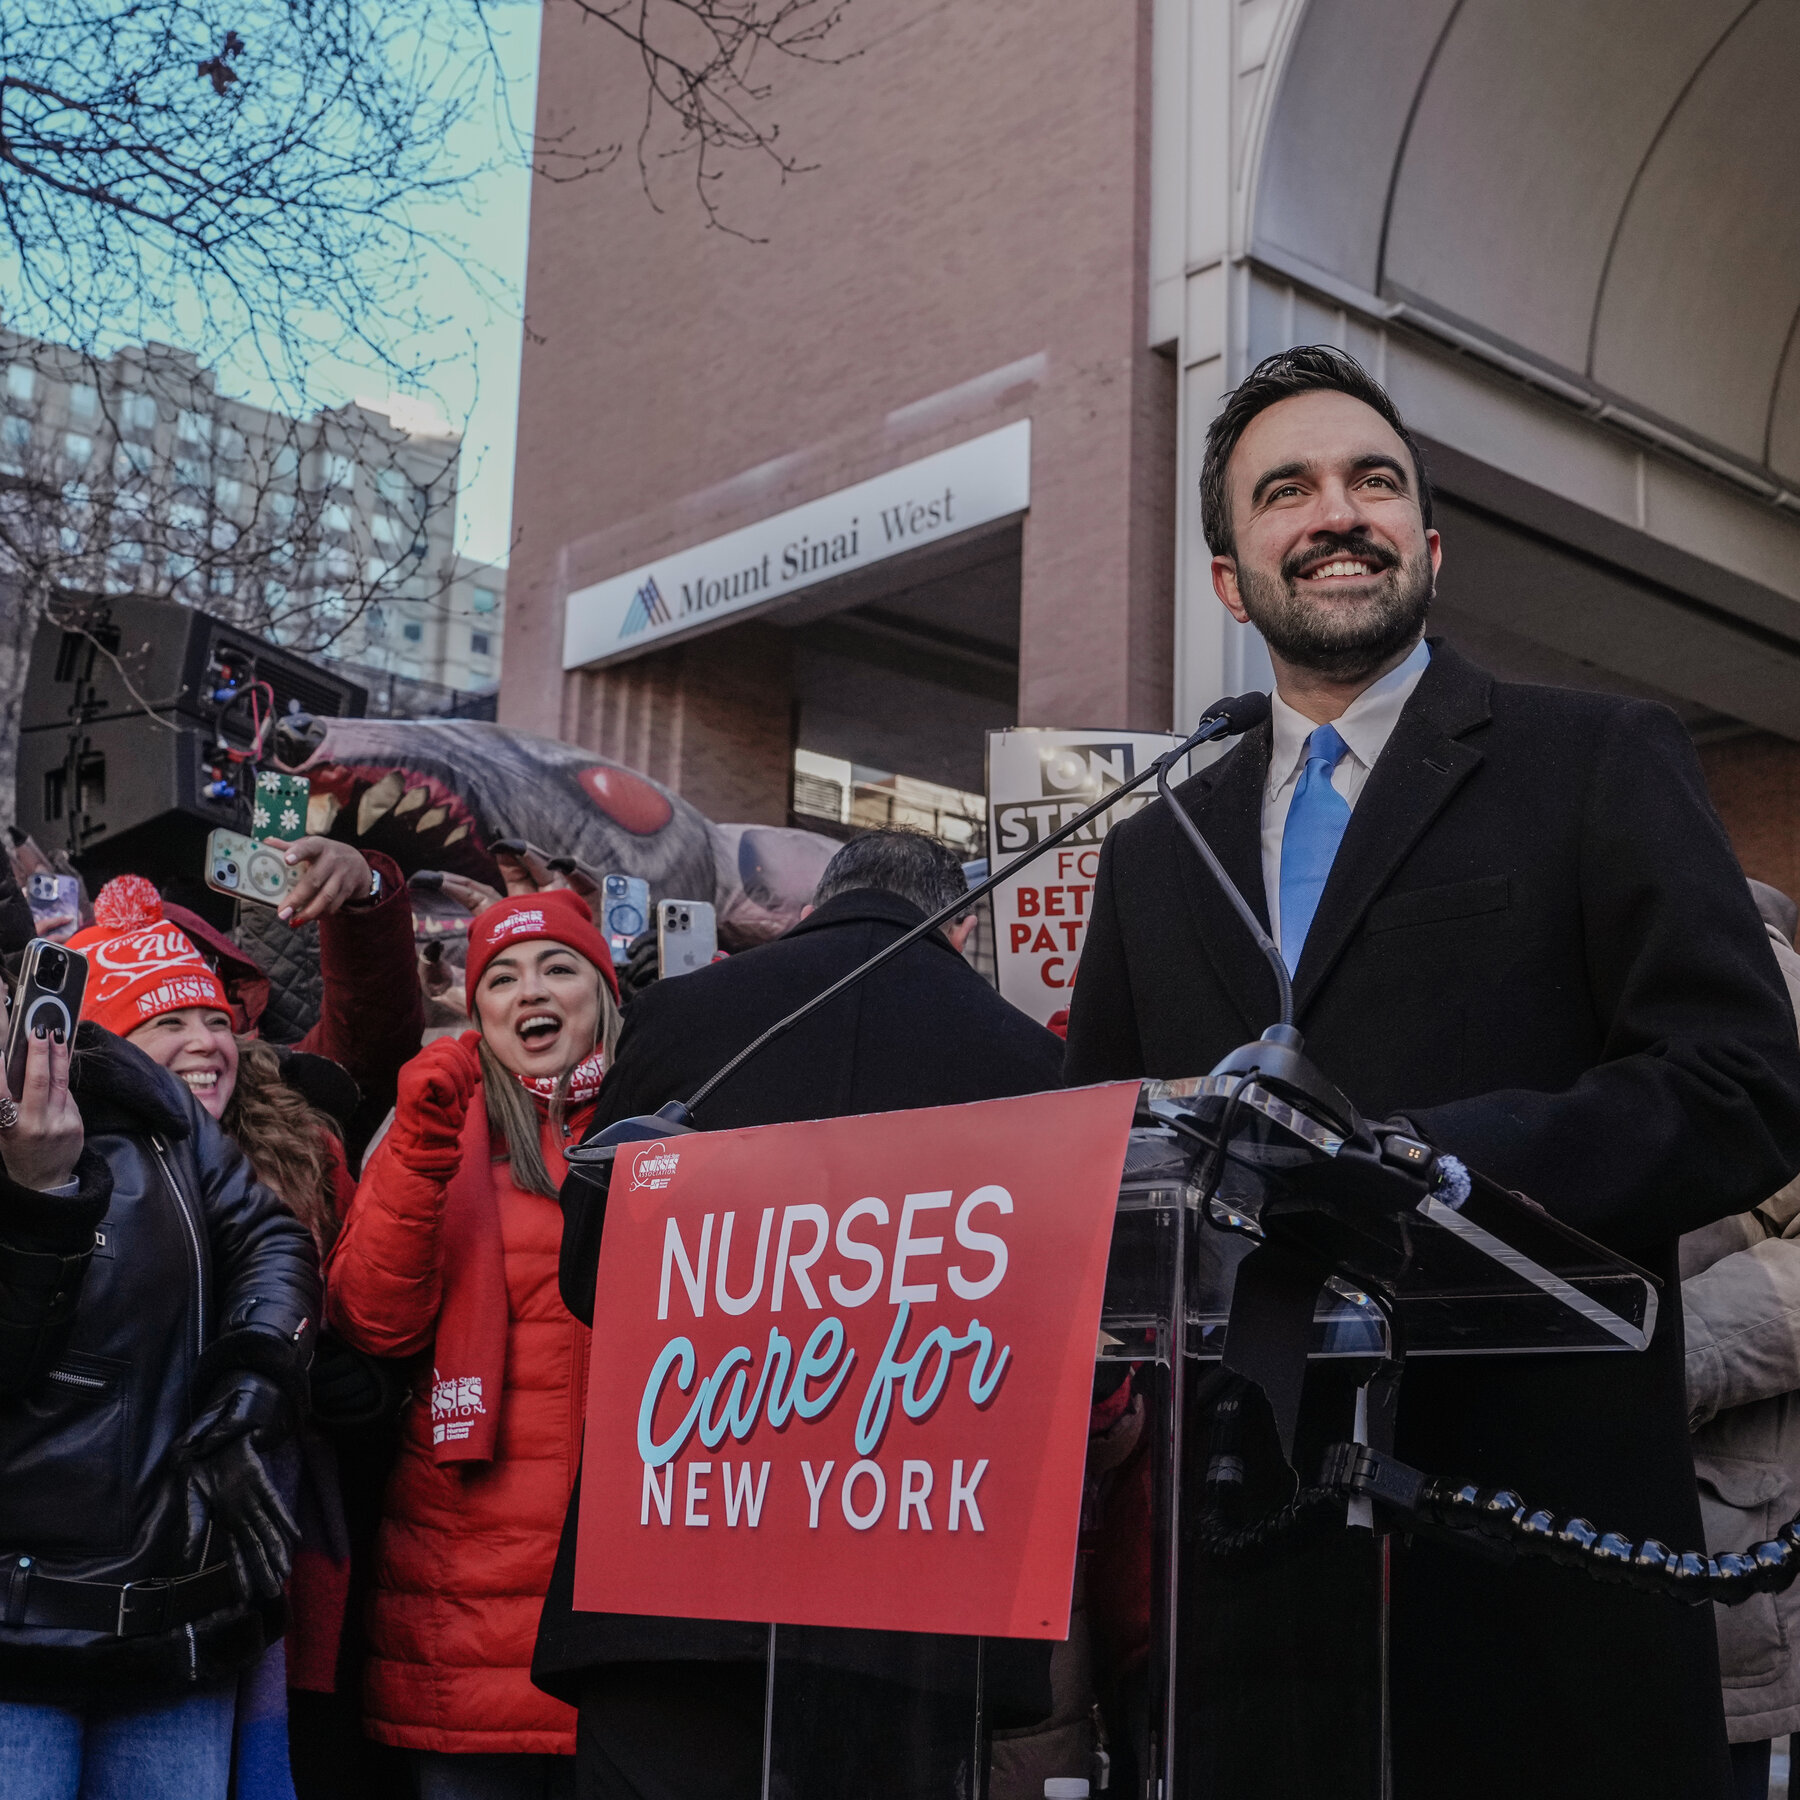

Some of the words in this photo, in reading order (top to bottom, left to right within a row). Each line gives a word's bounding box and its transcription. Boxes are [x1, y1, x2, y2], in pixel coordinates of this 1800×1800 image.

[679, 555, 771, 618] Mount
[781, 517, 860, 581] Sinai
[880, 488, 956, 544] West
[1046, 748, 1126, 795] ON
[1058, 850, 1100, 880] FO
[1017, 885, 1095, 918] BET
[131, 931, 190, 961] All
[1009, 920, 1090, 954] PAT
[136, 980, 216, 1014] NURSES
[638, 1169, 676, 1178] ASSOCIATION
[639, 1158, 679, 1174] NURSES
[657, 1184, 1014, 1320] NURSES
[439, 1378, 458, 1389] York
[459, 1376, 481, 1387] State
[637, 1316, 855, 1468] Care
[854, 1299, 1011, 1456] for
[447, 1420, 475, 1428] National
[447, 1427, 469, 1435] Nurses
[447, 1433, 469, 1441] United
[640, 1460, 771, 1528] NEW
[800, 1458, 990, 1532] YORK
